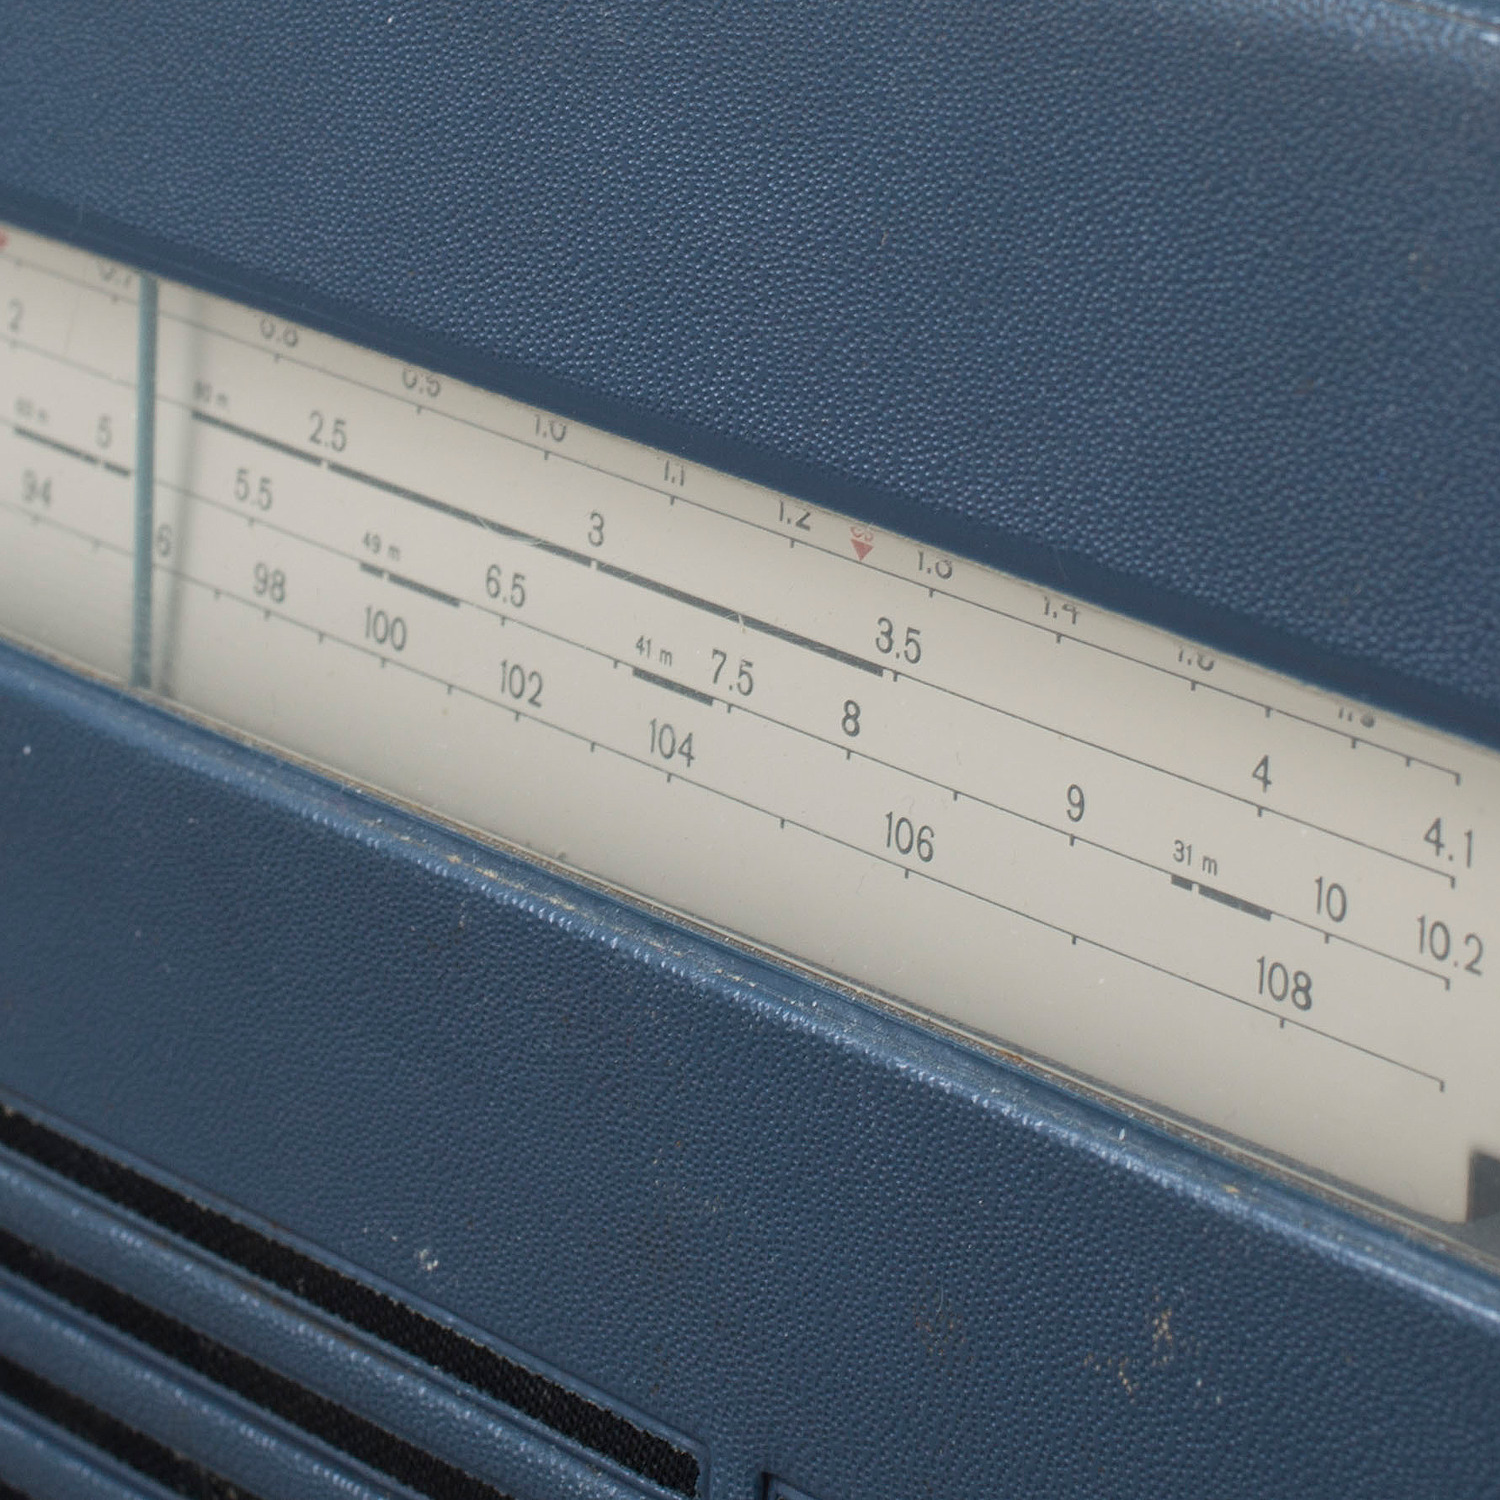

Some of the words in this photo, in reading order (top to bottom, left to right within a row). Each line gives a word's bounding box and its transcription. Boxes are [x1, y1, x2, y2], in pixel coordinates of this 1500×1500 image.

[234, 468, 273, 511] 5.5
[486, 565, 526, 608] 6.5
[711, 649, 753, 696] 7.5
[841, 700, 860, 737] 8
[1067, 784, 1085, 822] 9
[1314, 877, 1348, 923] 10
[1417, 915, 1484, 975] 10.2
[253, 562, 286, 603] 98
[364, 605, 408, 651] 100
[499, 660, 544, 708] 102
[649, 718, 695, 767] 104
[885, 811, 934, 862] 106
[1256, 956, 1313, 1011] 108
[309, 411, 347, 452] 2.5
[588, 511, 604, 547] 3
[875, 617, 922, 664] 3.5
[1252, 755, 1272, 792] 4
[1424, 818, 1474, 868] 4.1
[635, 636, 654, 659] 41
[660, 648, 673, 667] m
[1173, 840, 1193, 866] 31
[1202, 855, 1218, 876] m
